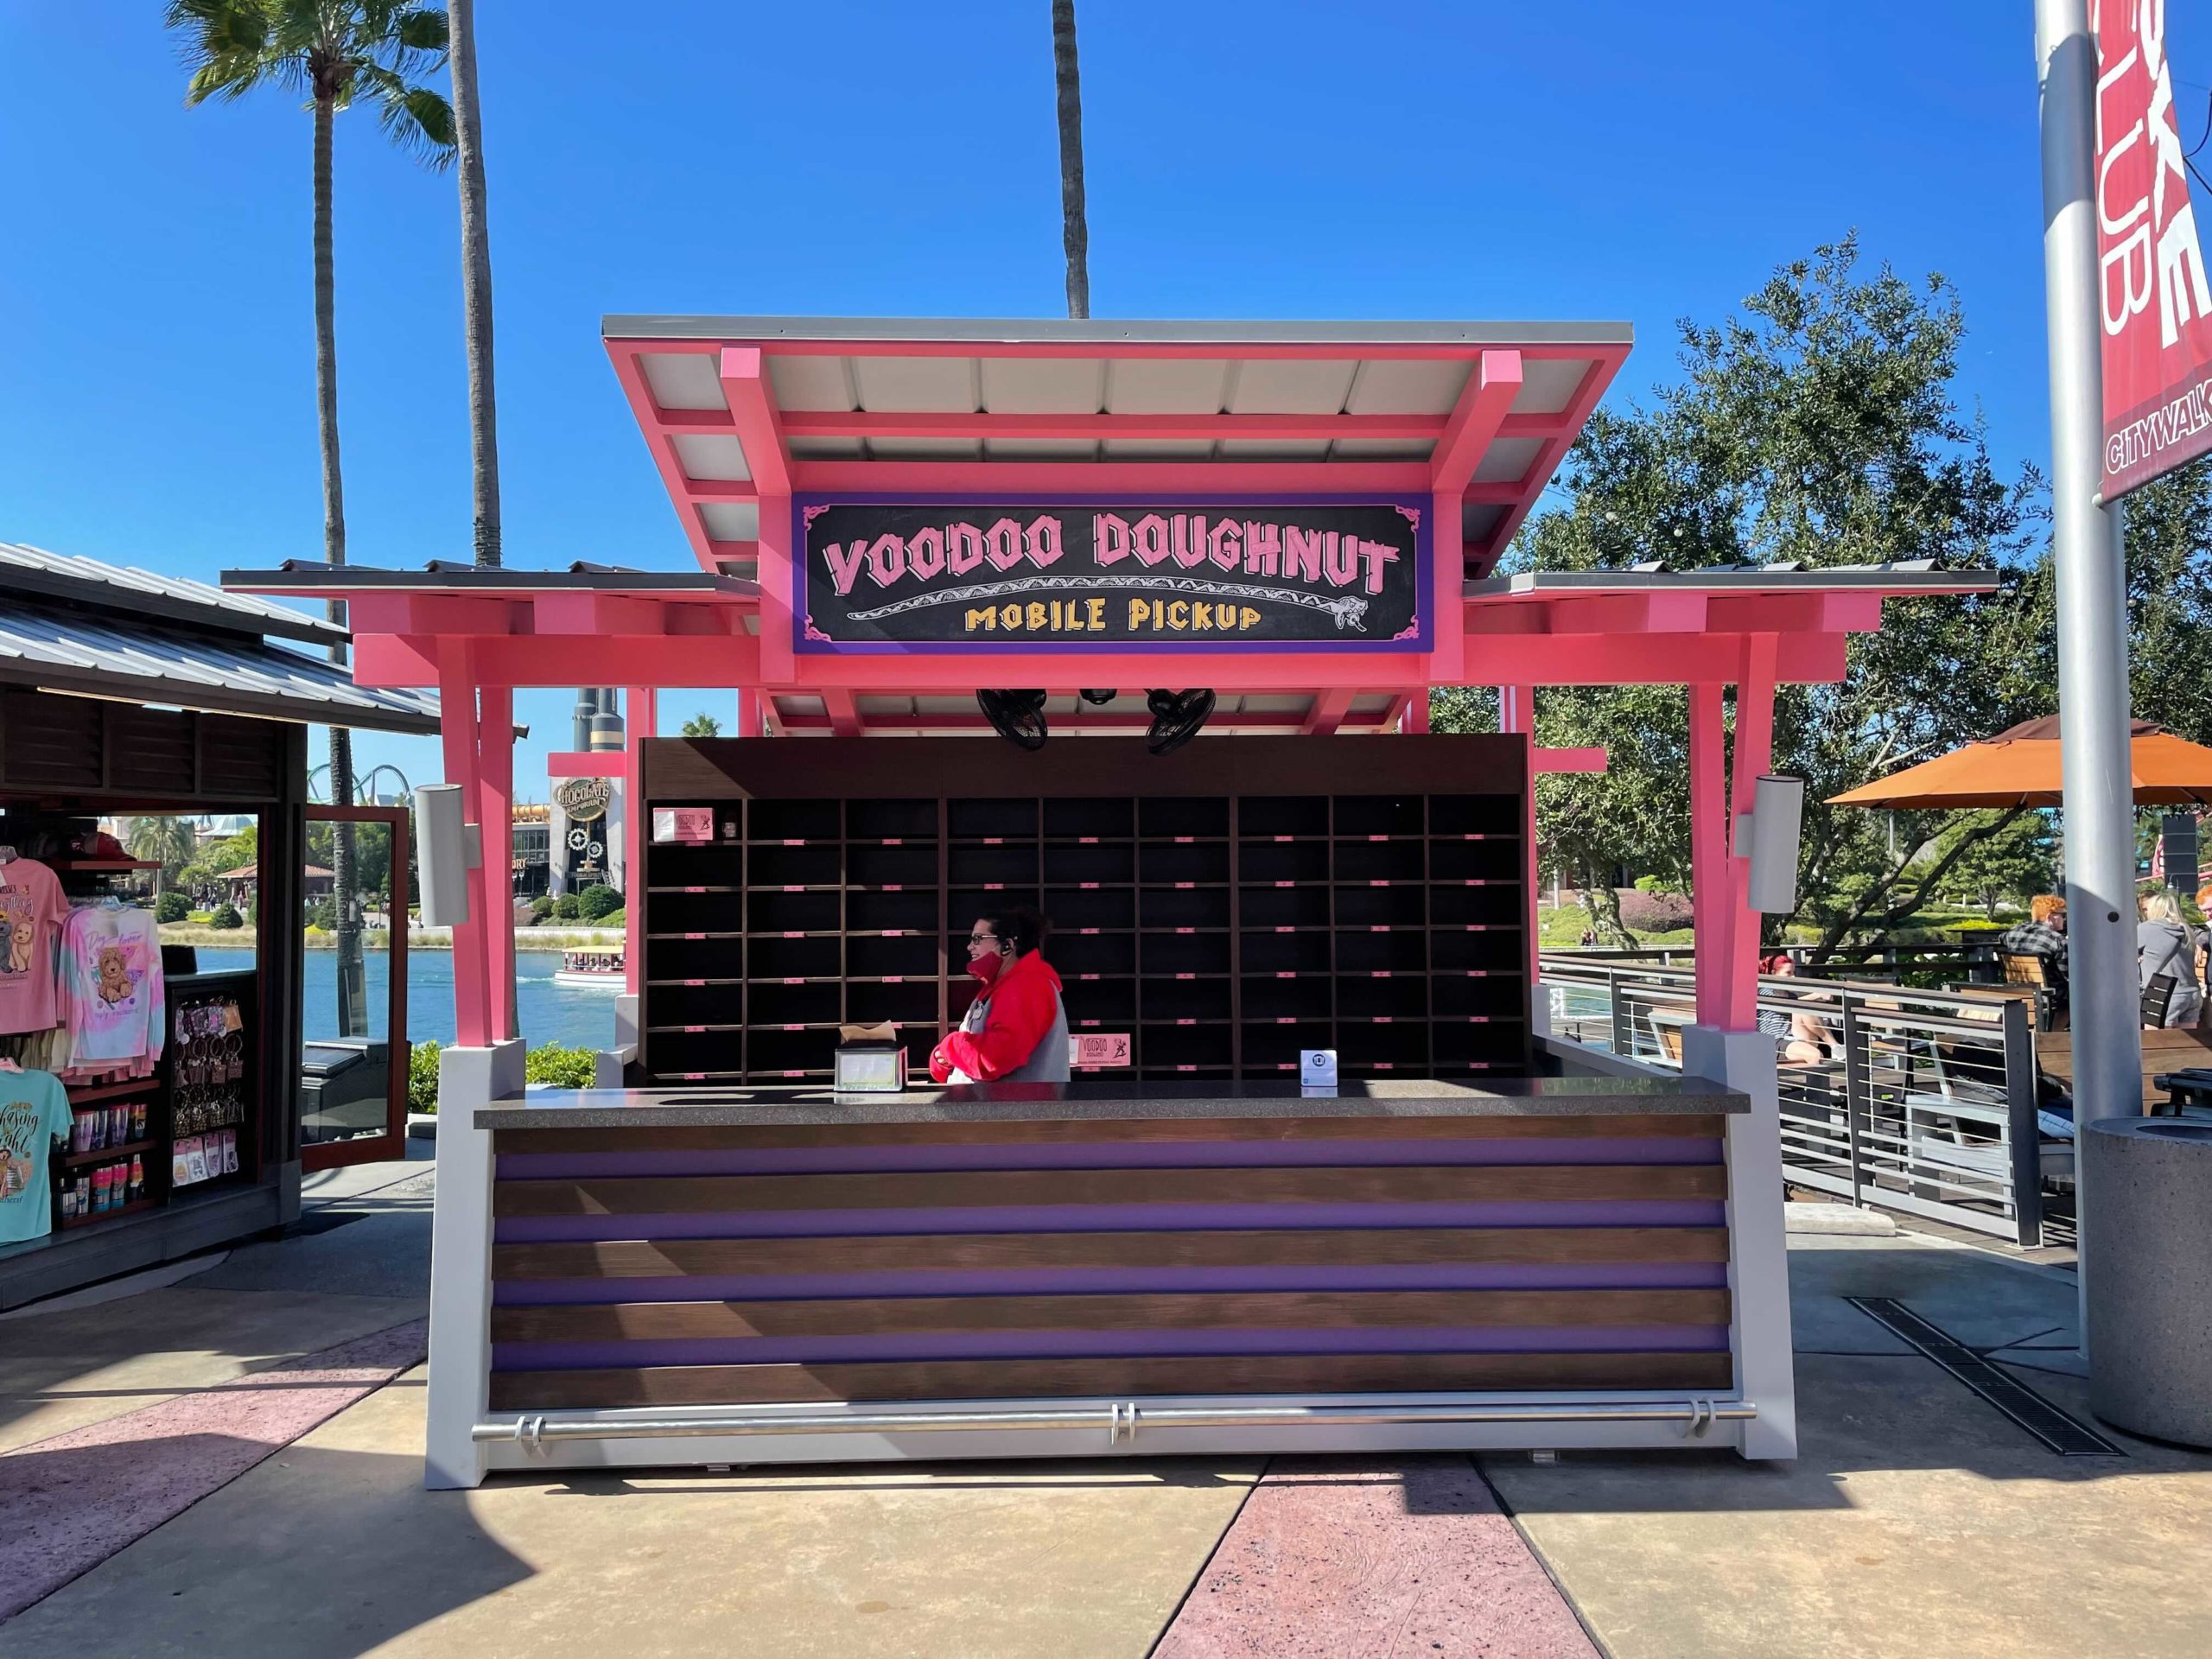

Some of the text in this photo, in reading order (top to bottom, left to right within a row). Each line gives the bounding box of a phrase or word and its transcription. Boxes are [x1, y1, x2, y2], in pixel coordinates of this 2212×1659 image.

[824, 512, 1399, 595] VOODOO DOUGHNUT
[965, 598, 1262, 631] MOBILE PICKUP
